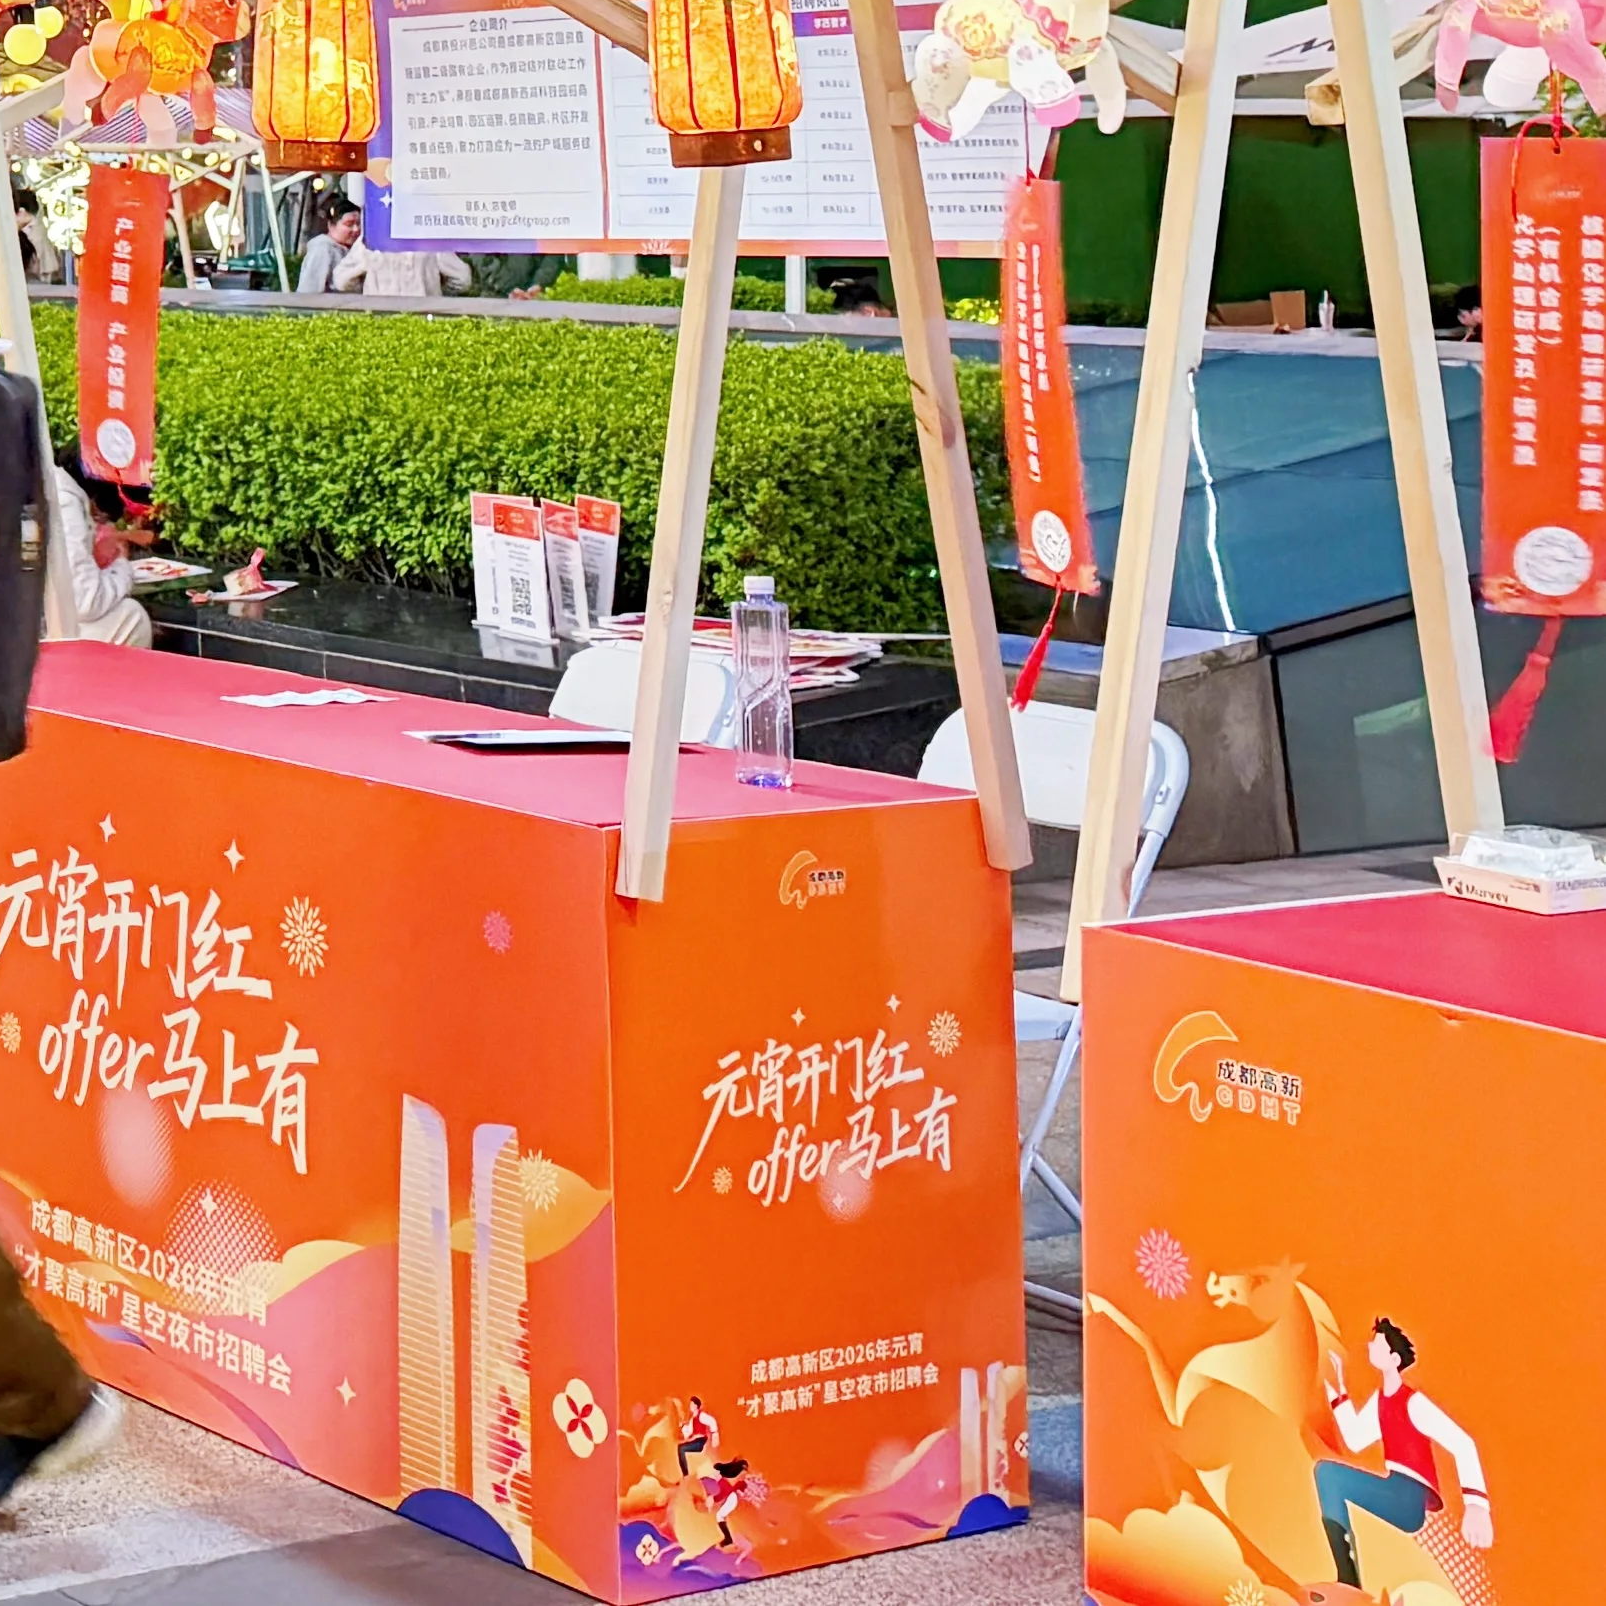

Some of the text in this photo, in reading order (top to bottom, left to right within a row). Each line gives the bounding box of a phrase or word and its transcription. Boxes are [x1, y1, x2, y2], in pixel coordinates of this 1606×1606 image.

[469, 17, 509, 33] 企业简介
[38, 988, 319, 1175] offer马上有
[674, 1028, 925, 1194] 元宵开门红
[1216, 1060, 1301, 1099] 成都高新
[1216, 1084, 1301, 1126] CDHT
[747, 1085, 958, 1208] offer马上有
[30, 1198, 269, 1326] 成都高新区2026年元宵
[15, 1243, 292, 1396] “才聚高新”星空夜市招聘会
[750, 1331, 925, 1387] 成都高新区2026年元宵
[737, 1362, 940, 1419] “才聚高新”星空夜市招聘会
